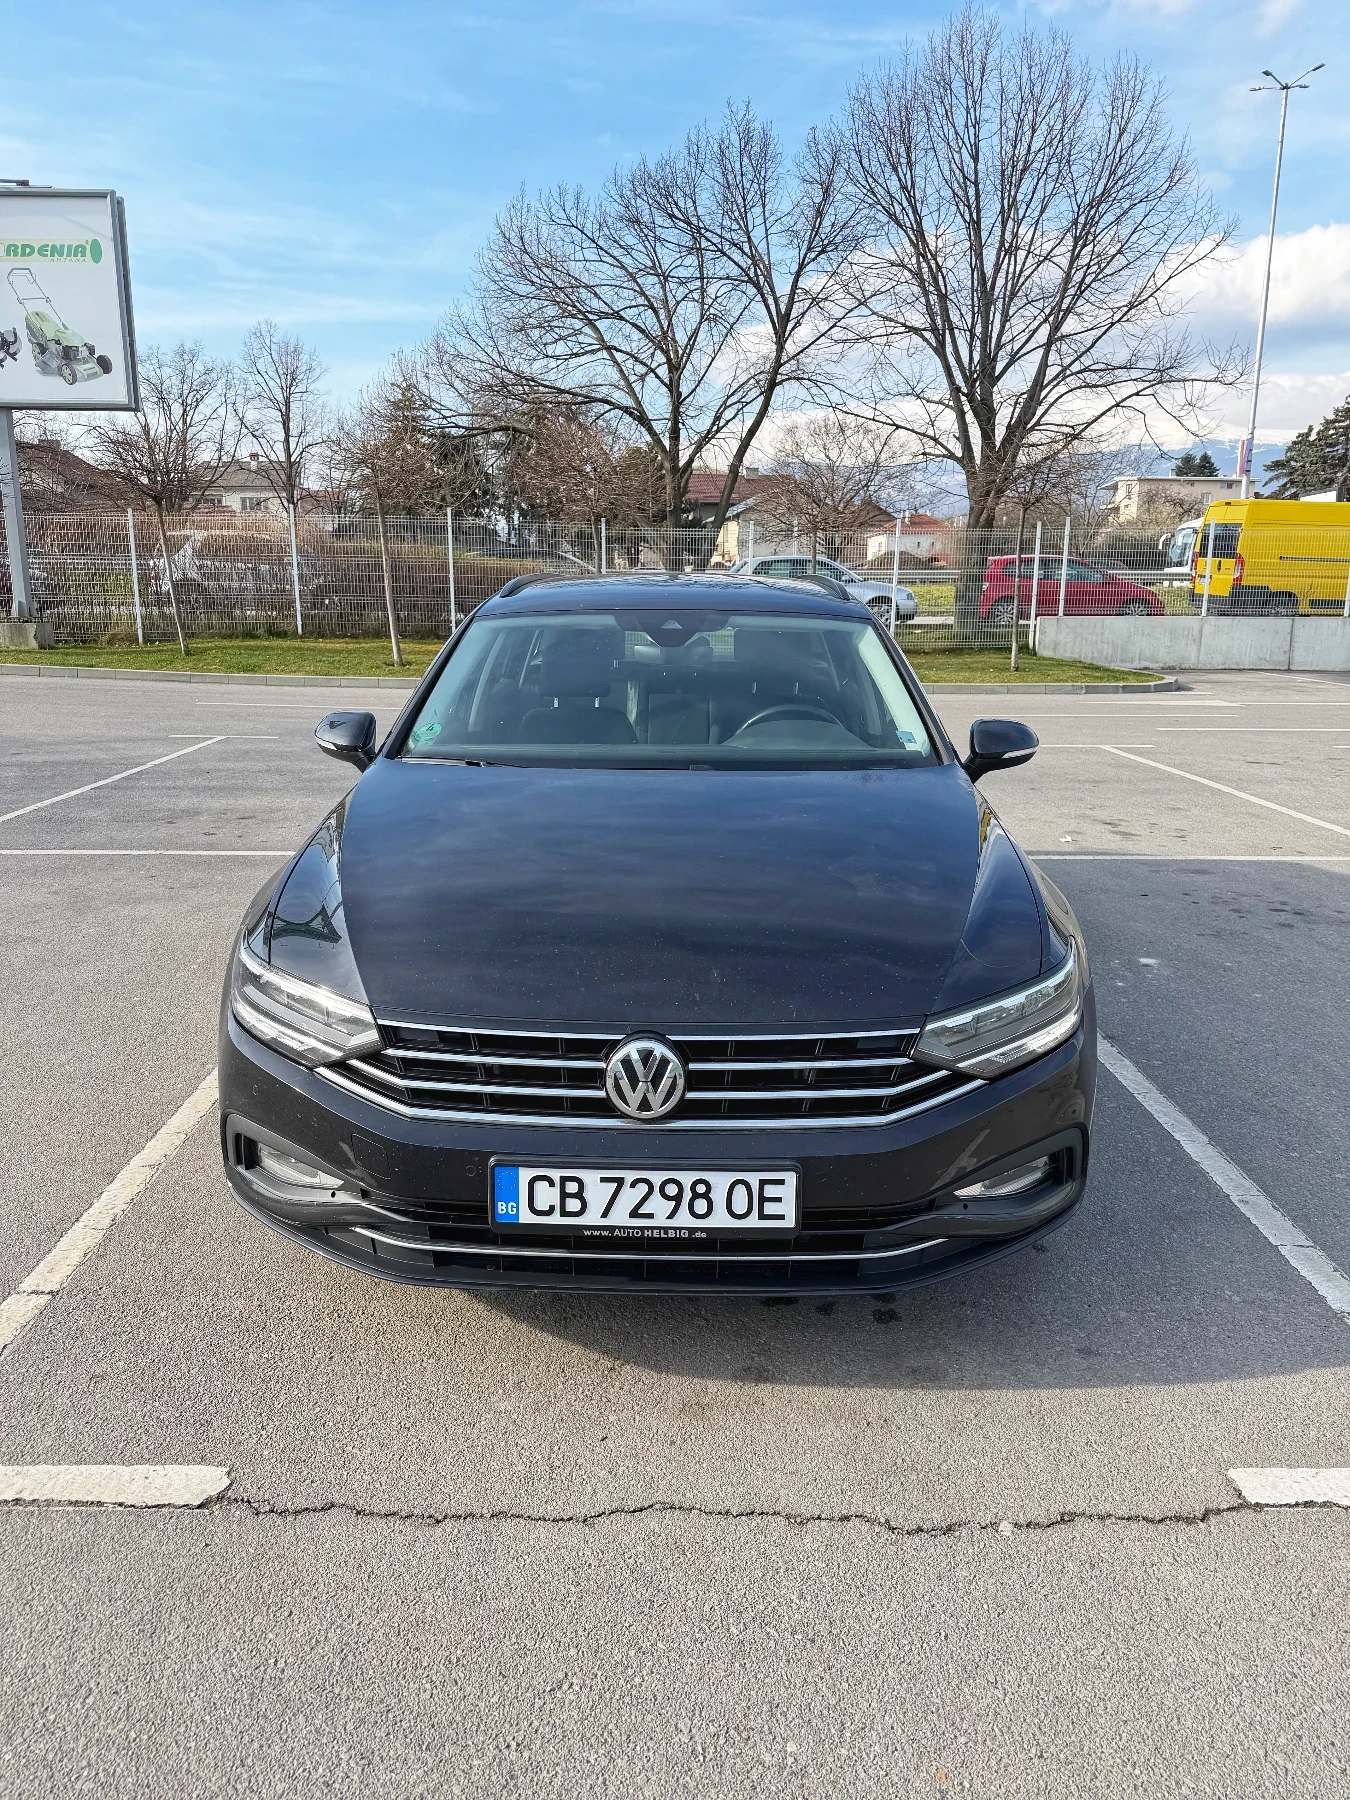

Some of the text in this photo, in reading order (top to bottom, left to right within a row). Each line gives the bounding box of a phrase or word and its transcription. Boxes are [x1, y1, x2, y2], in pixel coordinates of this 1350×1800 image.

[606, 1040, 684, 1119] VW
[497, 1201, 517, 1215] BG
[527, 1174, 786, 1221] CB 7298 OE
[613, 1228, 641, 1237] AUTO
[644, 1229, 689, 1238] HELBIG
